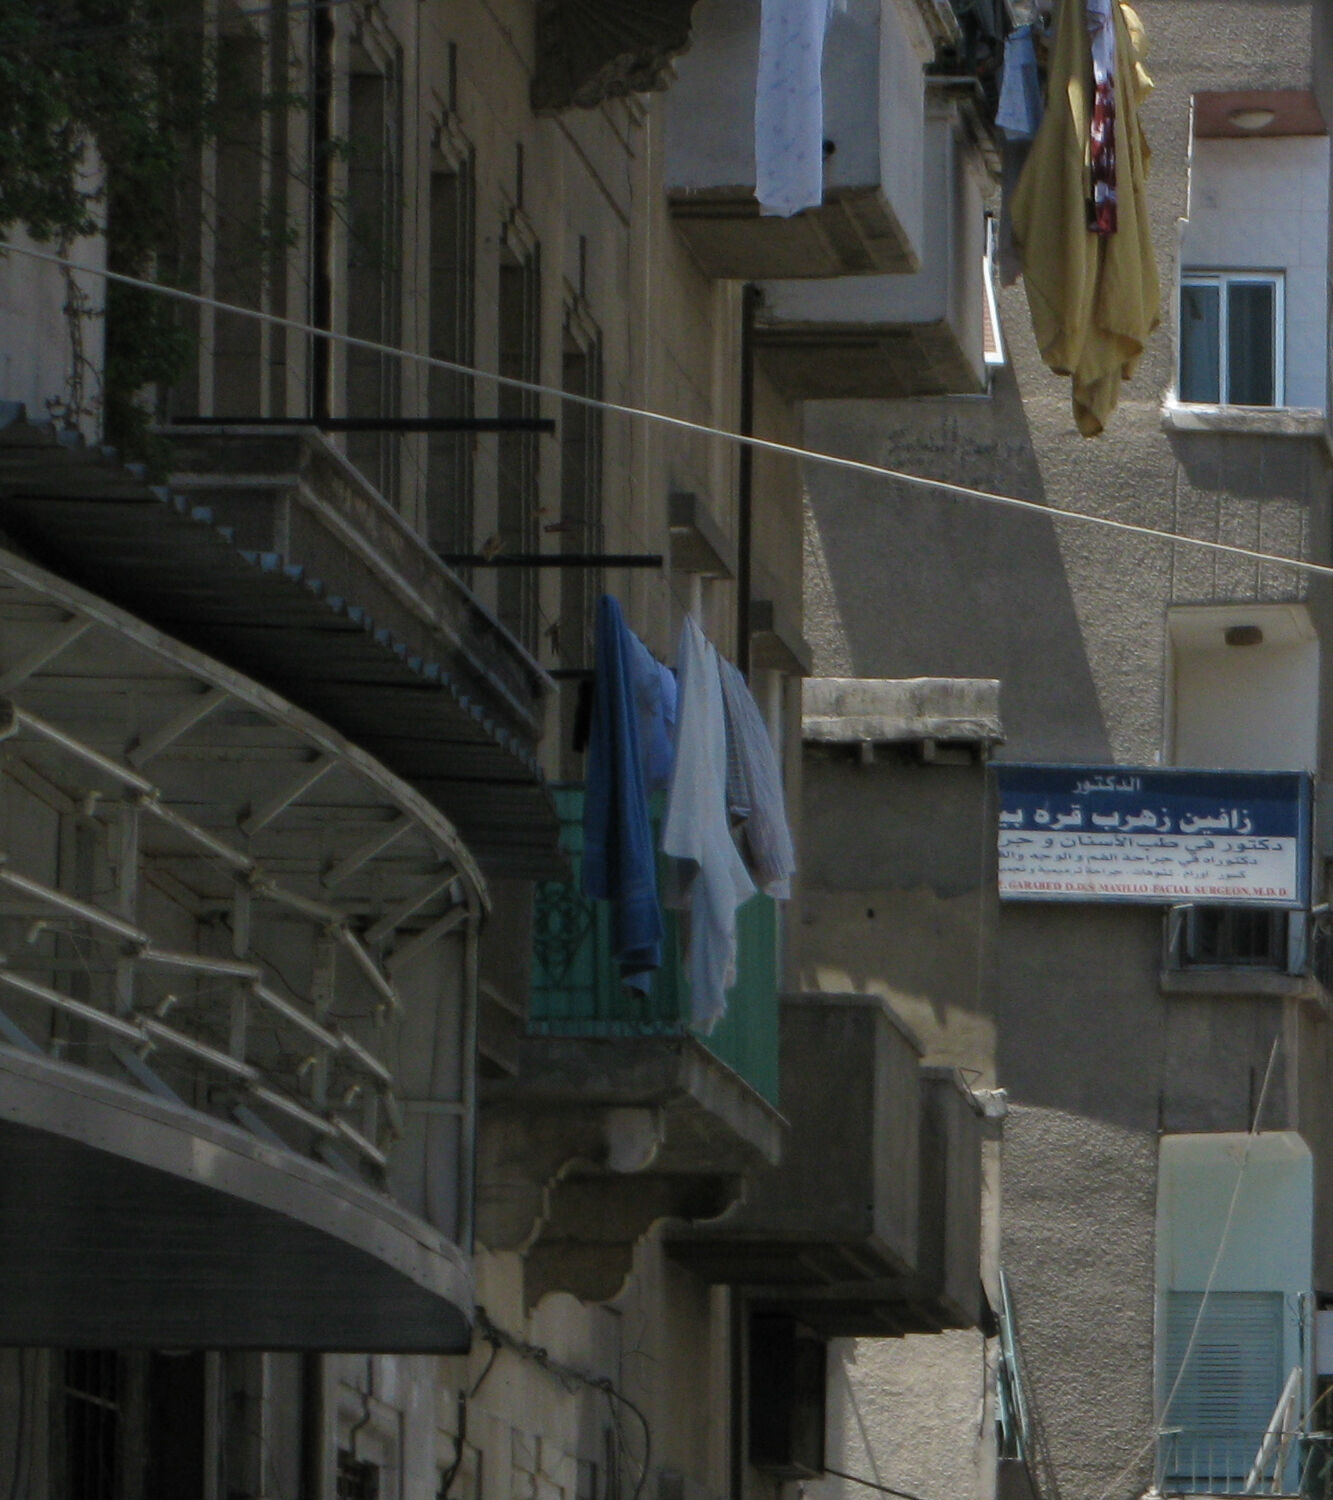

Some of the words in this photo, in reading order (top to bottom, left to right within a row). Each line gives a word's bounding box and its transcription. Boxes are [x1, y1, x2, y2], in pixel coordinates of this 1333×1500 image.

[1072, 775, 1141, 795] الدكتور
[1179, 807, 1252, 834] زافين
[1000, 836, 1034, 848] جر
[1042, 837, 1054, 848] و
[1059, 834, 1133, 848] الأسنان
[1136, 837, 1179, 851] طب
[1184, 837, 1216, 855] في
[1222, 838, 1283, 852] دكتور
[1087, 852, 1118, 864] الفم
[1122, 853, 1173, 865] جراحة
[1178, 853, 1200, 868] في
[1203, 855, 1258, 867] دكتوراه
